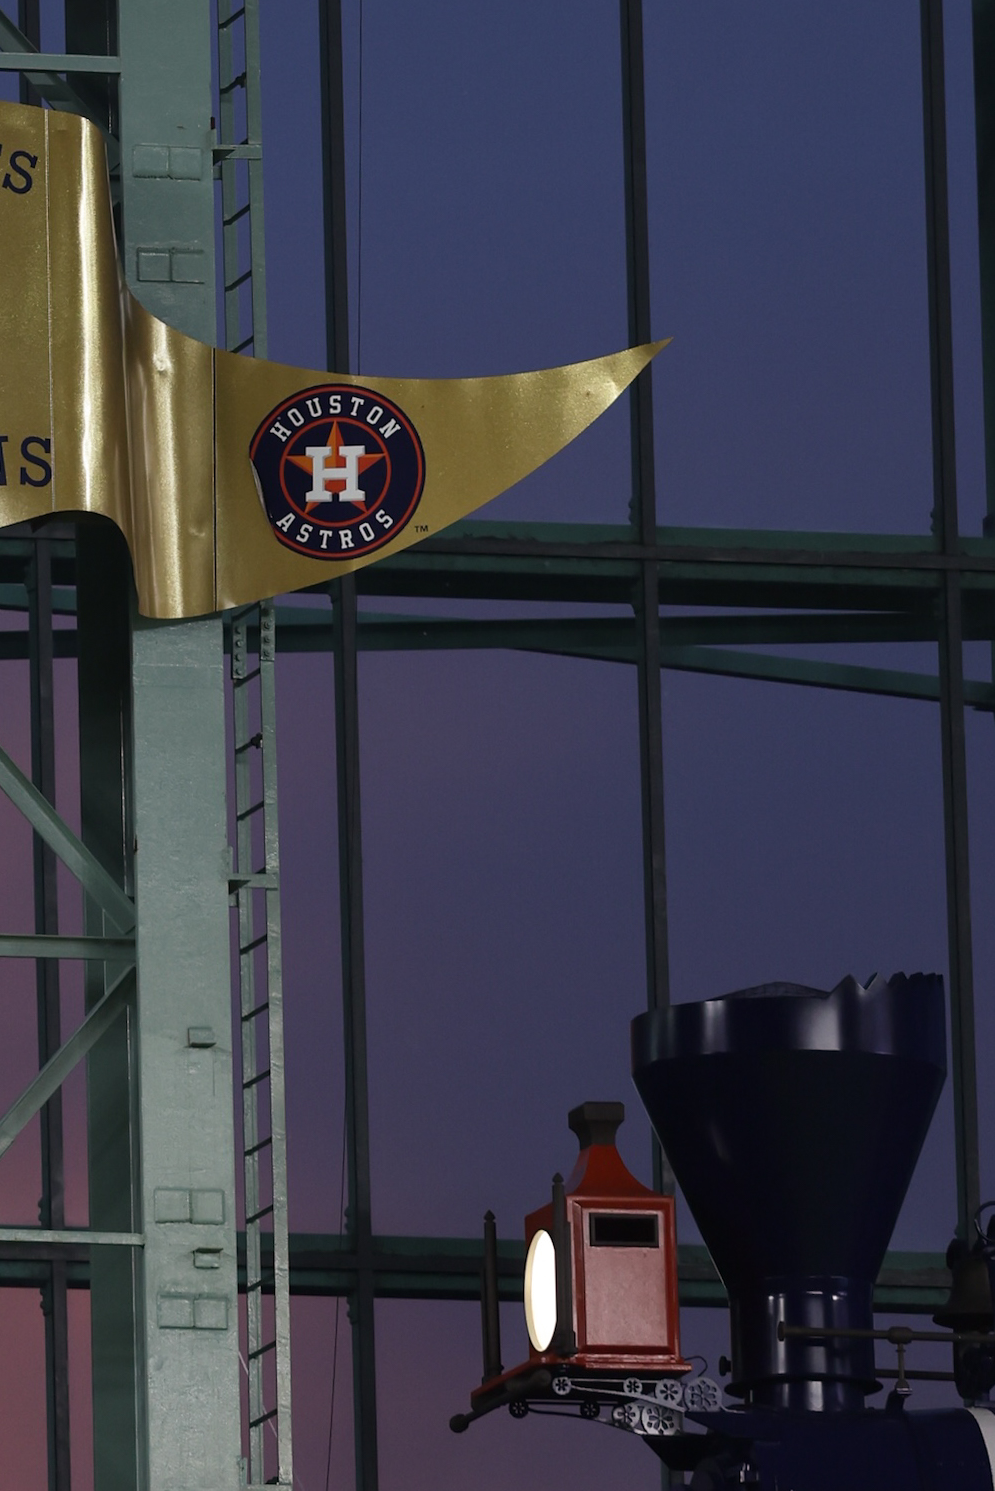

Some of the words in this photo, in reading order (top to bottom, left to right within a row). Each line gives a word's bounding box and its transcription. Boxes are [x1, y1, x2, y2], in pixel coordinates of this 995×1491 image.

[269, 394, 402, 442] HOUSTON
[304, 444, 366, 503] H
[275, 508, 394, 550] ASTROS
[414, 525, 429, 533] TM
